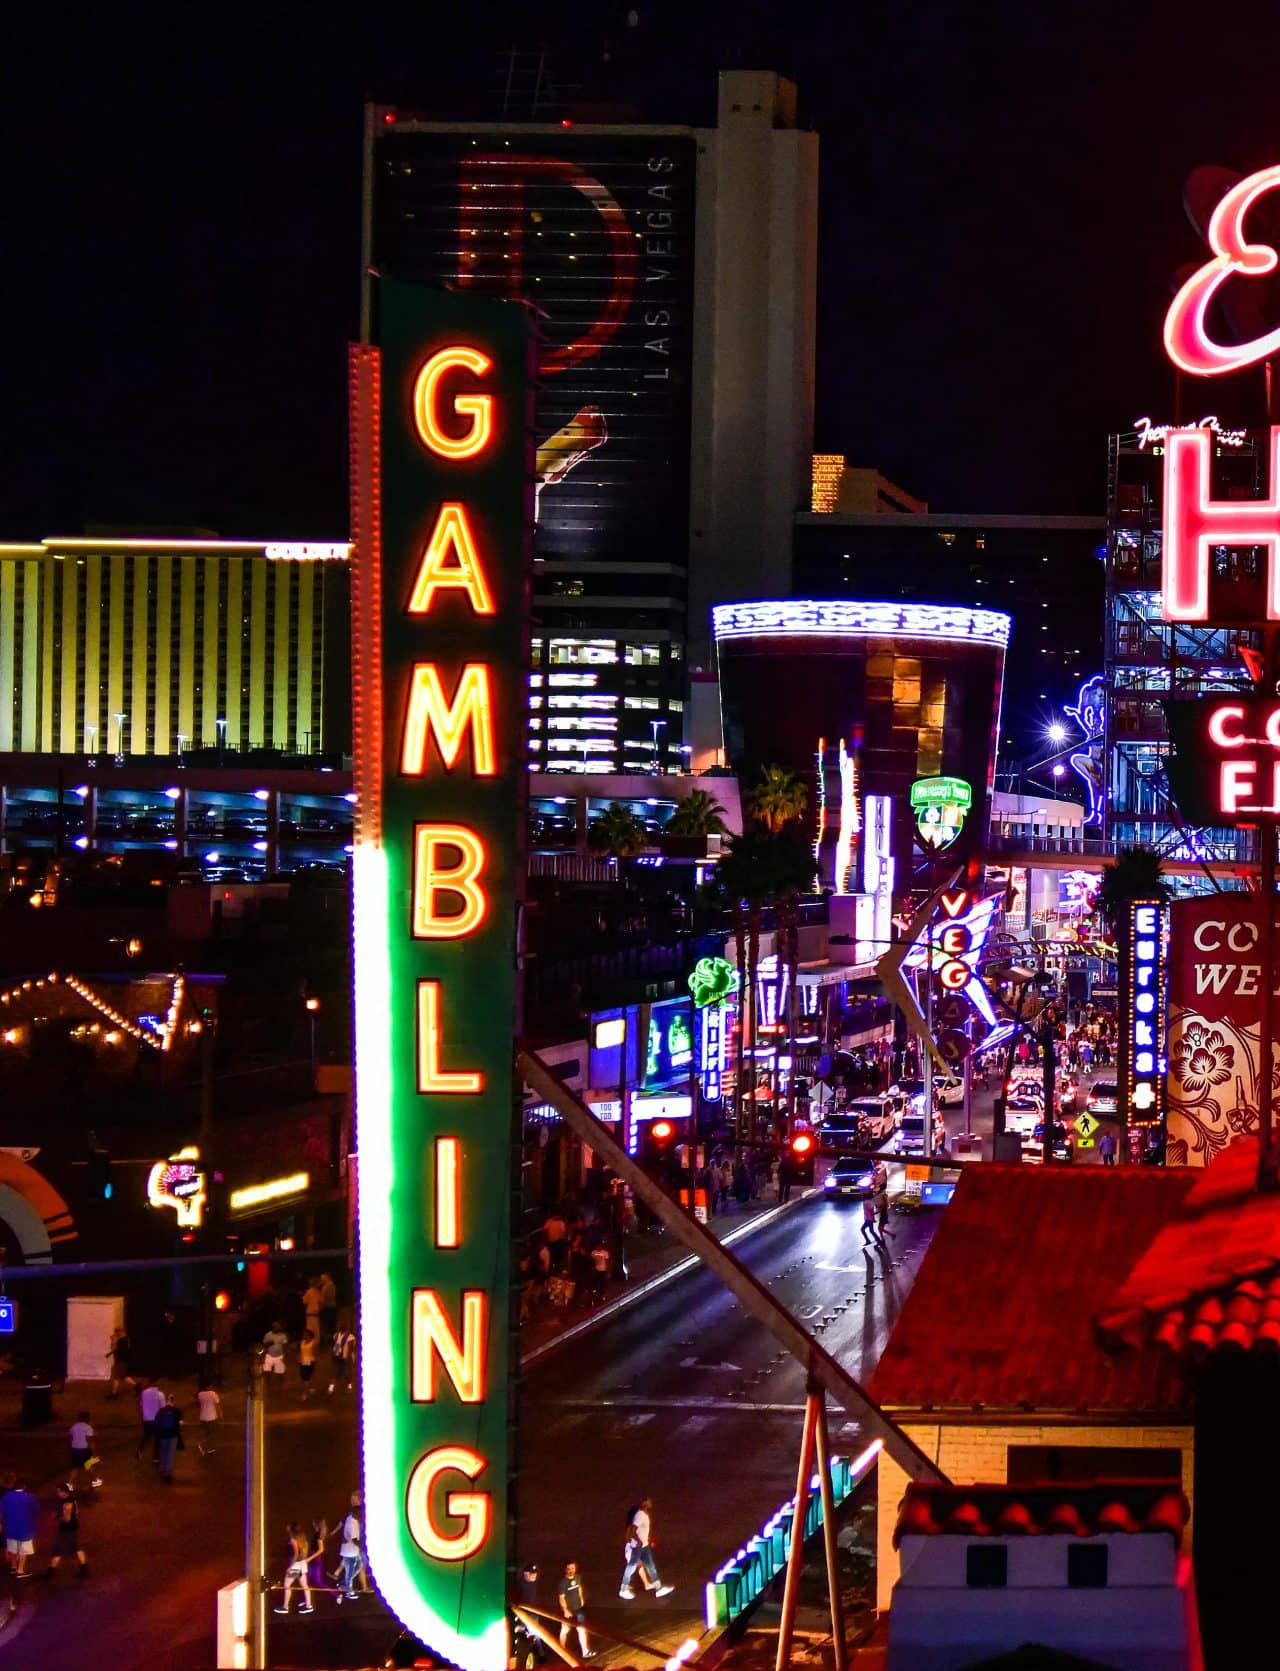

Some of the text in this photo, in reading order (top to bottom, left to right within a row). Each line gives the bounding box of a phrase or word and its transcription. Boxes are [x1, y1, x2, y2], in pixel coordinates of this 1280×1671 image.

[644, 157, 674, 380] LAS VEGAS
[402, 346, 496, 1564] GAMBLING
